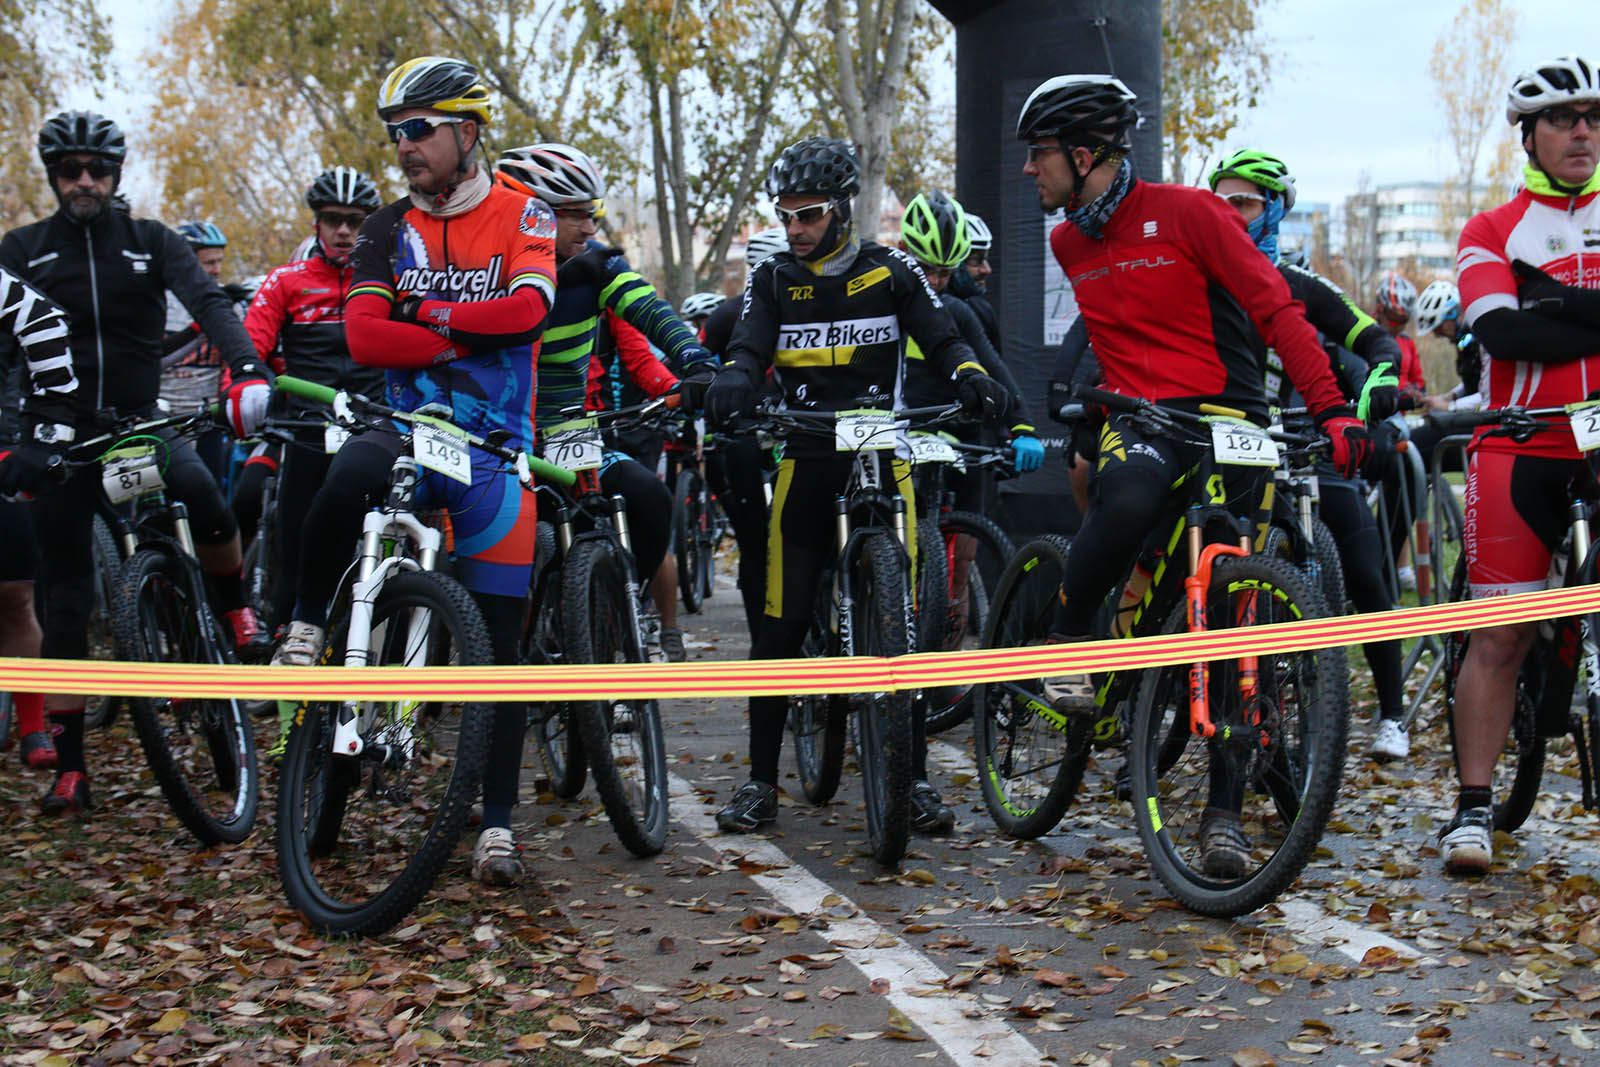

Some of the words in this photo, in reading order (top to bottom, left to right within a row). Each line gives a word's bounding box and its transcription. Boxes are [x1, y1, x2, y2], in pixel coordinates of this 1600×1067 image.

[396, 253, 502, 294] martorell
[787, 285, 815, 301] RR
[780, 328, 822, 349] RR
[825, 321, 891, 348] Bikers
[854, 425, 878, 439] 67
[561, 443, 584, 461] 70
[1225, 434, 1263, 452] 187
[425, 440, 461, 467] 149
[119, 471, 141, 490] 87
[1466, 508, 1479, 565] CICLISTA
